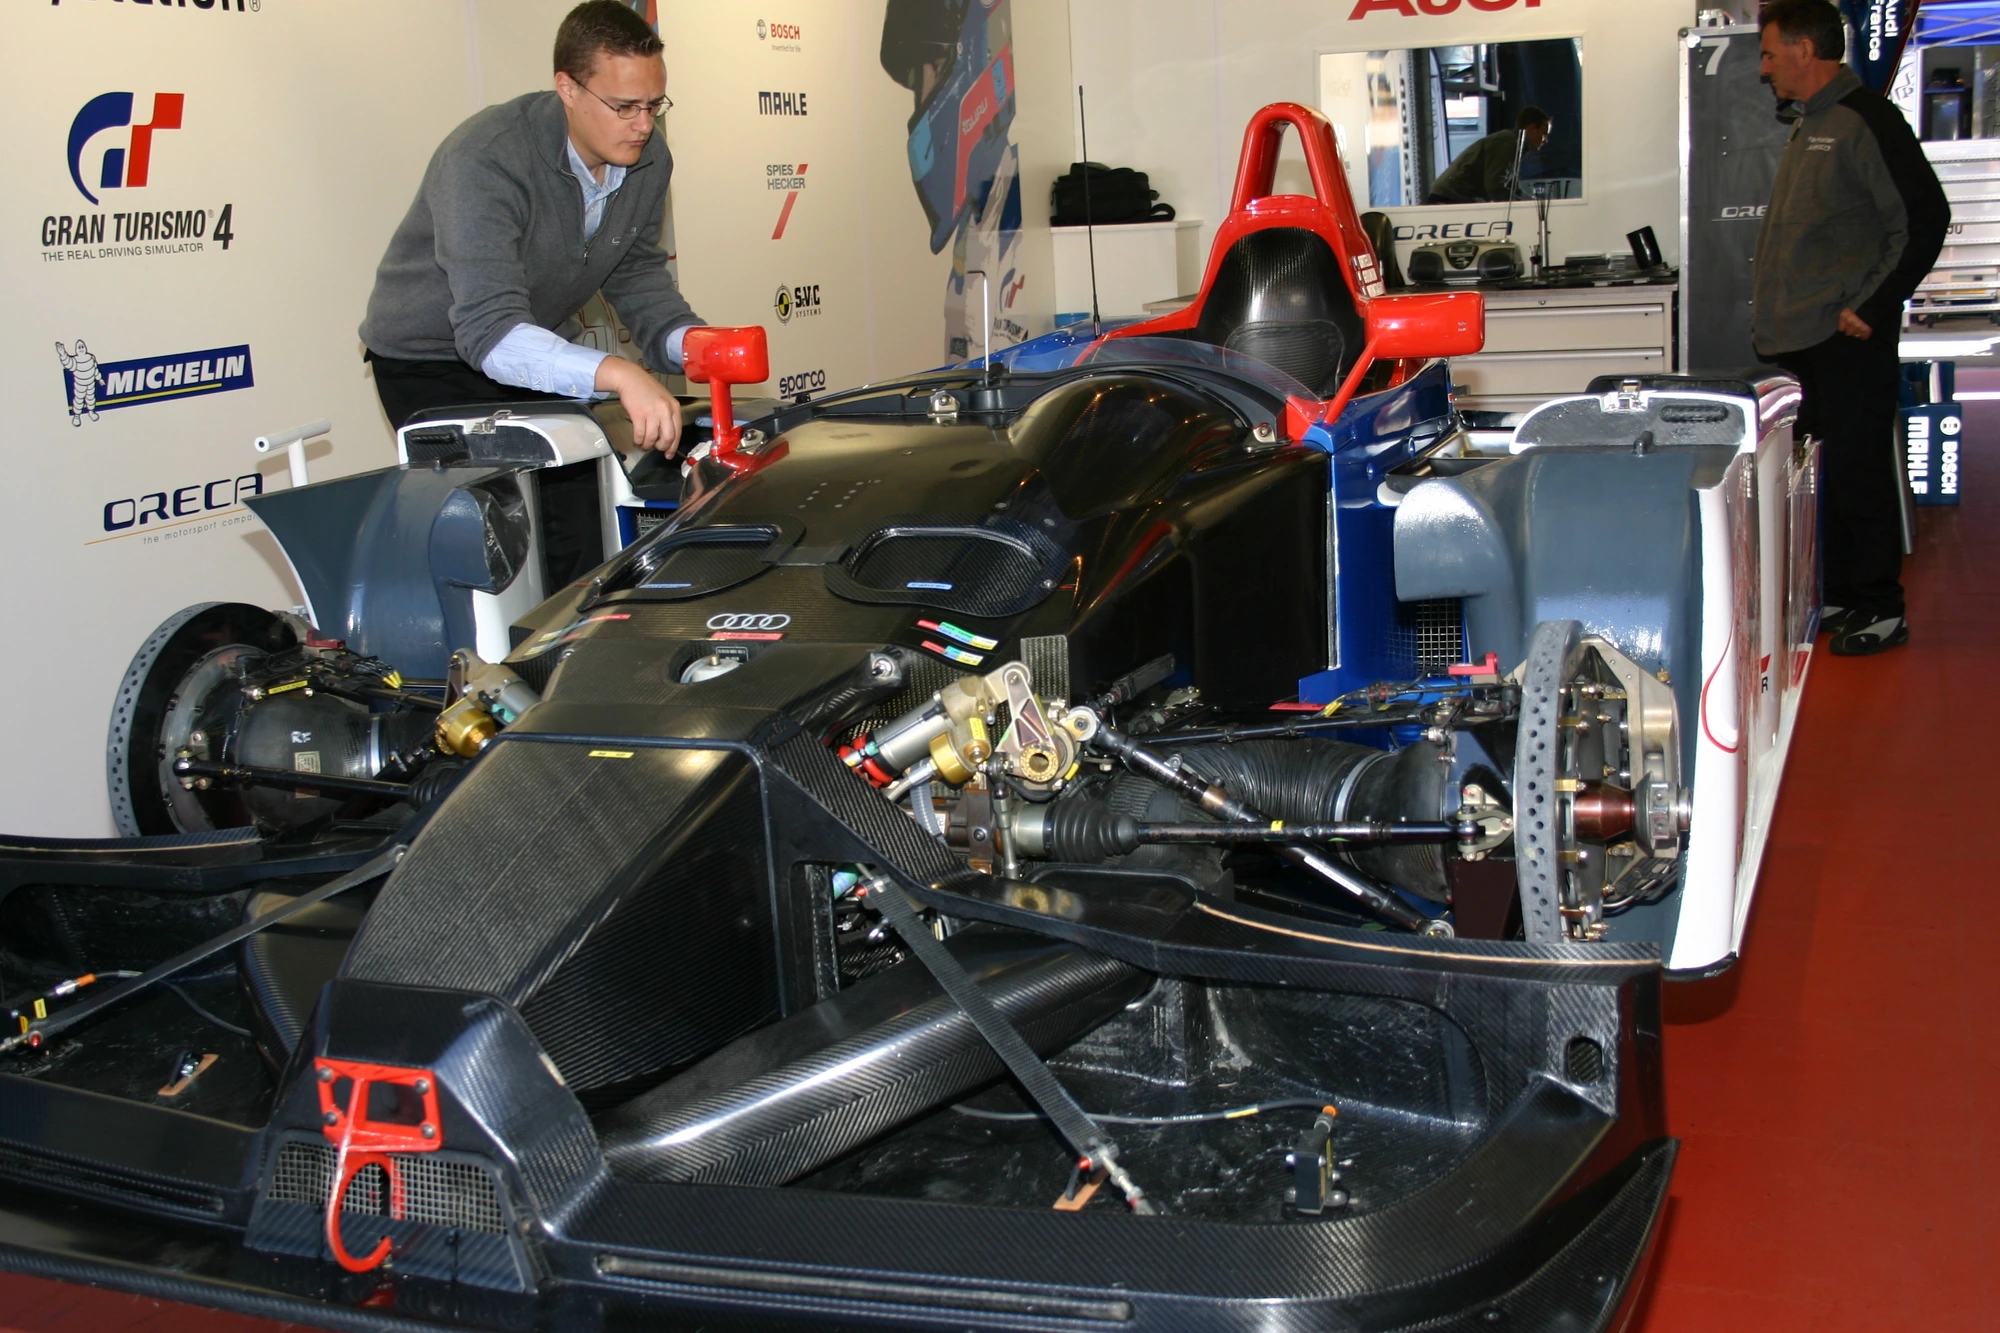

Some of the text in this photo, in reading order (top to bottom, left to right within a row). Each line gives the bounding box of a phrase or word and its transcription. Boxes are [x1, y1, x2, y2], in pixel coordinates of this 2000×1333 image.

[771, 23, 801, 40] BOSCH
[1701, 37, 1730, 75] 7
[758, 91, 807, 116] MAHLE
[766, 164, 794, 176] SPIES
[767, 177, 806, 190] HECKER
[1721, 206, 1768, 218] ORE
[41, 203, 234, 250] GRAN TURISMO 4
[1394, 220, 1513, 241] ORECA
[42, 242, 204, 262] THE REAL DRIVING SIMULATOR
[796, 308, 822, 318] SYSTEMS
[106, 355, 245, 396] MICHELIN
[779, 369, 826, 398] sparco
[1941, 441, 1958, 494] BOSCH
[103, 472, 263, 532] ORECA
[143, 513, 257, 545] the motorsport compa
[291, 731, 312, 743] RF
